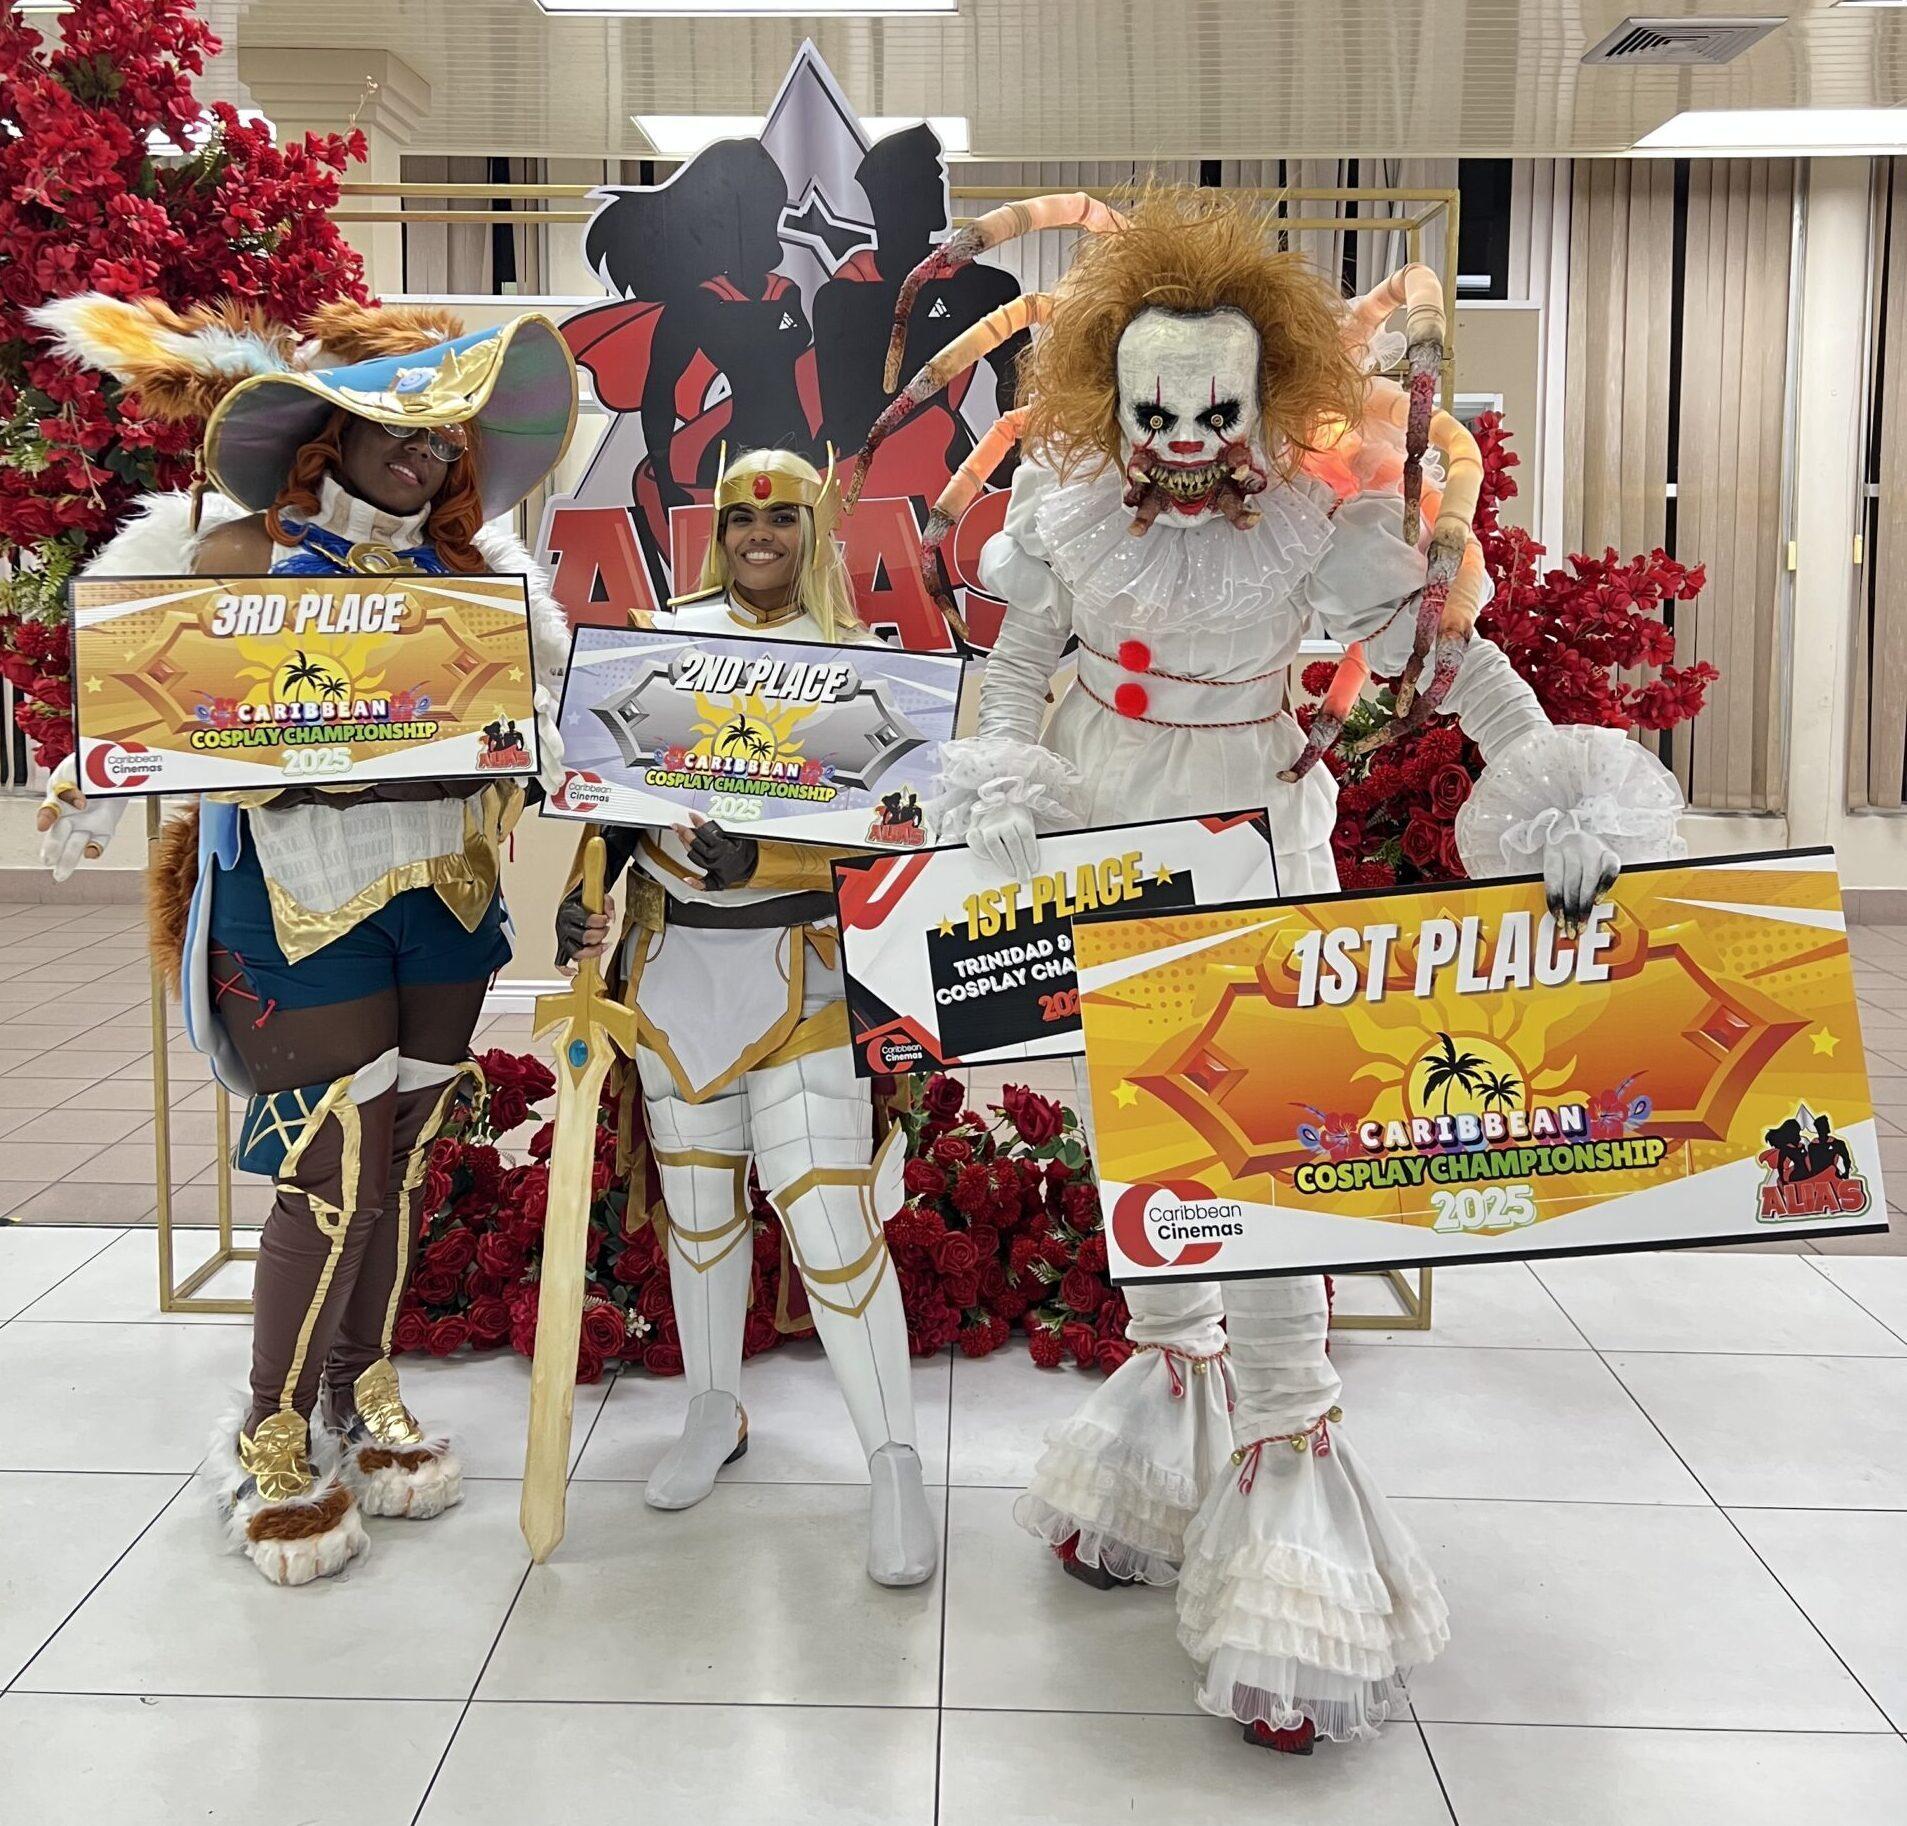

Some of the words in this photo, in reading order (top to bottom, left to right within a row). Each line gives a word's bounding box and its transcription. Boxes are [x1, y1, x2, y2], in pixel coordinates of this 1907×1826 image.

[211, 594, 288, 636] 3RD
[294, 592, 407, 634] PLACE
[675, 654, 745, 694] 2ND
[745, 657, 849, 703] PLACE
[237, 698, 389, 723] CARIBBEAN
[191, 727, 283, 749] COSPLAY
[283, 720, 439, 746] CHAMPIONSHIP
[108, 755, 163, 765] Caribbean
[112, 764, 163, 774] Cinemas
[281, 747, 354, 776] 2025
[684, 752, 800, 781] CARIBBEAN
[568, 782, 612, 794] Caribbean
[569, 791, 610, 803] Cinemas
[645, 769, 714, 793] COSPLAY
[713, 776, 838, 802] CHAMPIONSHIP
[706, 795, 764, 822] 2025
[962, 883, 1024, 941] 1ST
[1032, 850, 1143, 926] PLACE
[953, 939, 1054, 978] TRINIDAD
[1057, 934, 1072, 951] &
[1293, 922, 1398, 1007] 1ST
[1414, 902, 1615, 997] PLACE
[936, 967, 1027, 1005] COSPLAY
[881, 1044, 922, 1055] Caribbean
[885, 1052, 923, 1062] Cinemas
[1358, 1104, 1587, 1150] CARIBBEAN
[1295, 1155, 1427, 1194] COSPLAY
[1427, 1137, 1668, 1185] CHAMPIONSHIP
[1149, 1203, 1242, 1222] Caribbean
[1430, 1184, 1538, 1233] 2025
[1760, 1178, 1867, 1218] ALIAS
[1157, 1222, 1244, 1240] Cinemas
